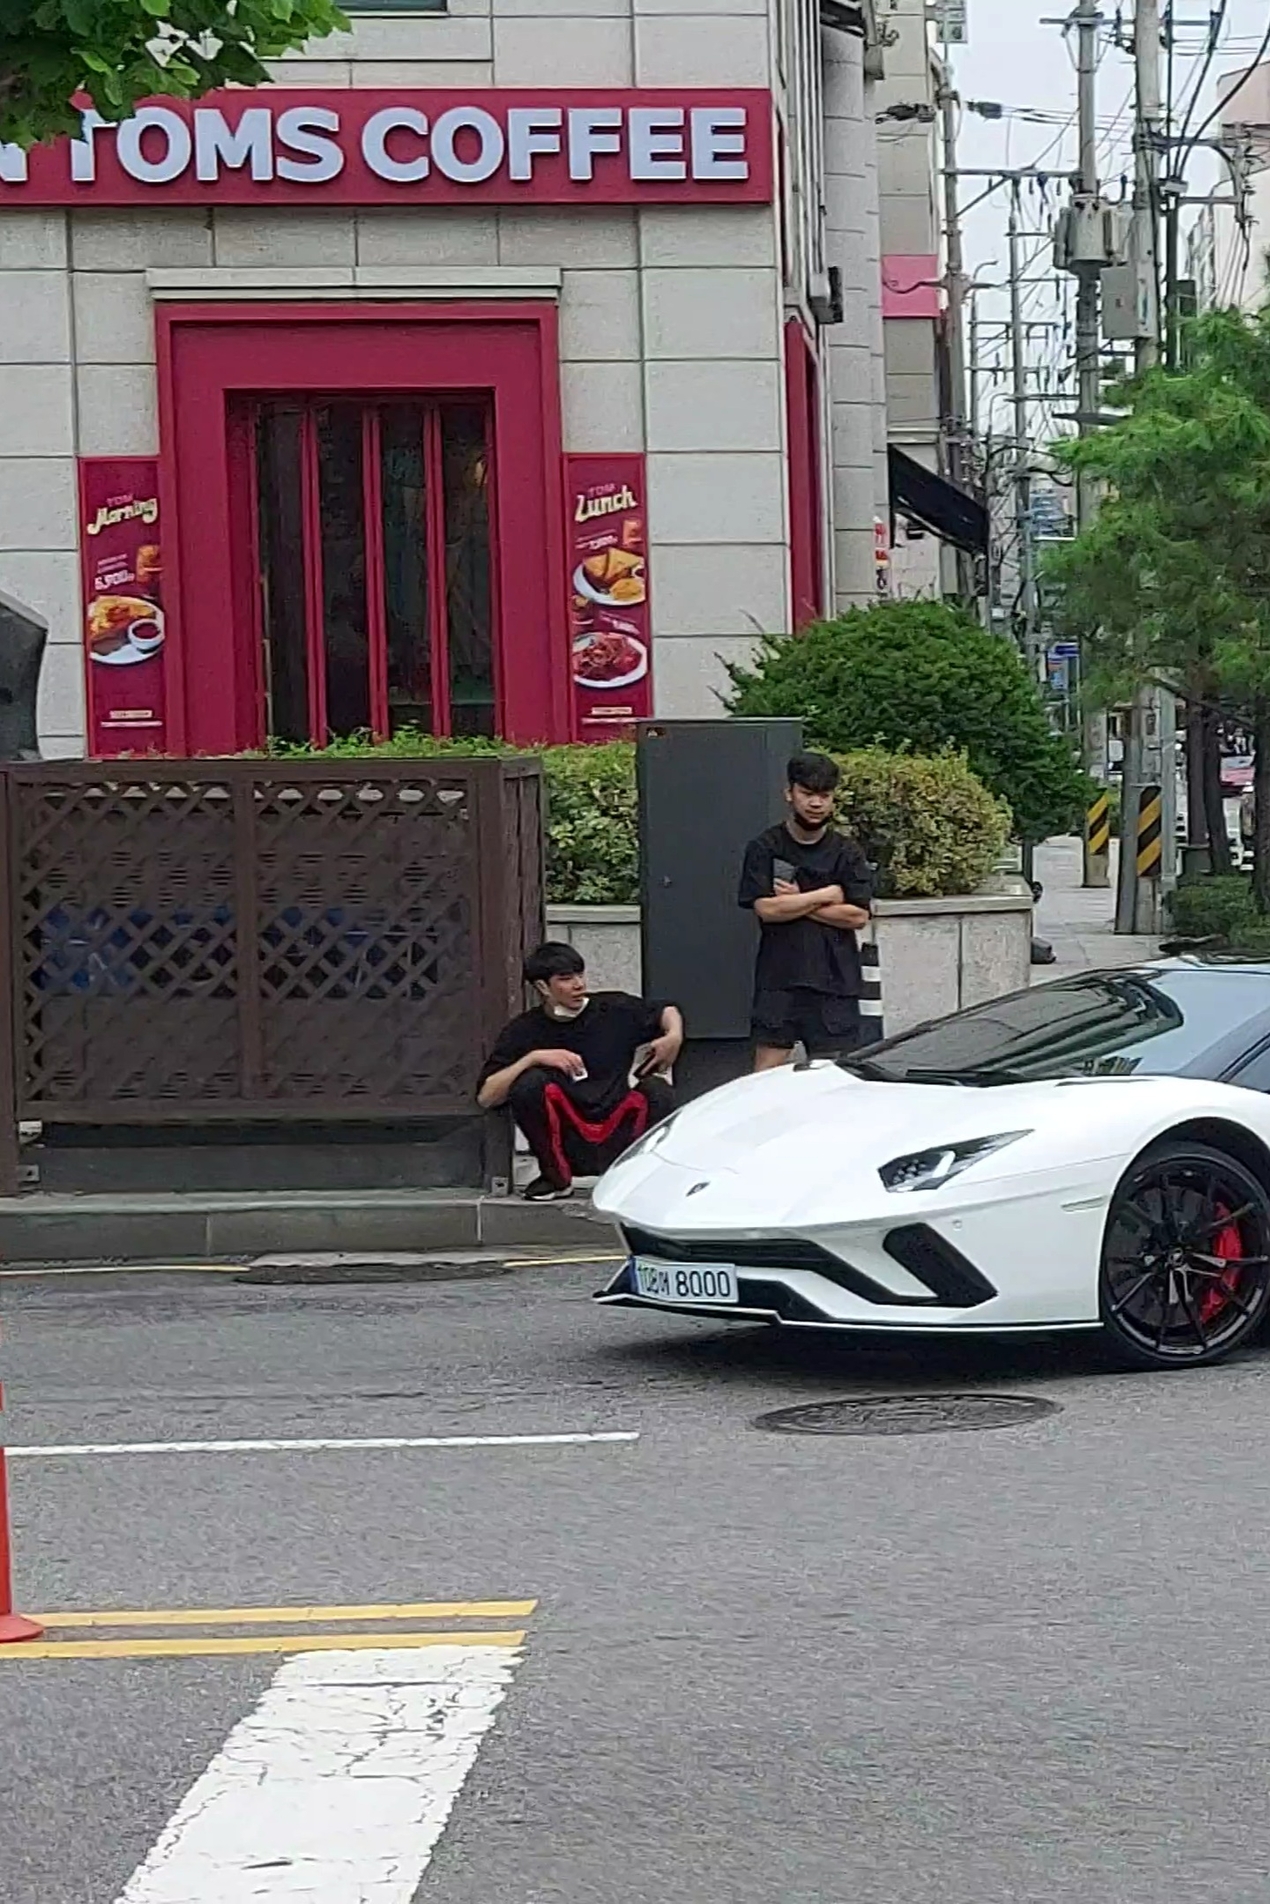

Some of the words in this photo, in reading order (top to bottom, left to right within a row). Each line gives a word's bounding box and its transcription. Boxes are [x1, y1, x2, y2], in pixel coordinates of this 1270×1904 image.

[361, 106, 748, 183] COFFEE
[87, 498, 157, 535] Morning
[574, 485, 638, 523] Lunch
[676, 1270, 731, 1297] 8000
